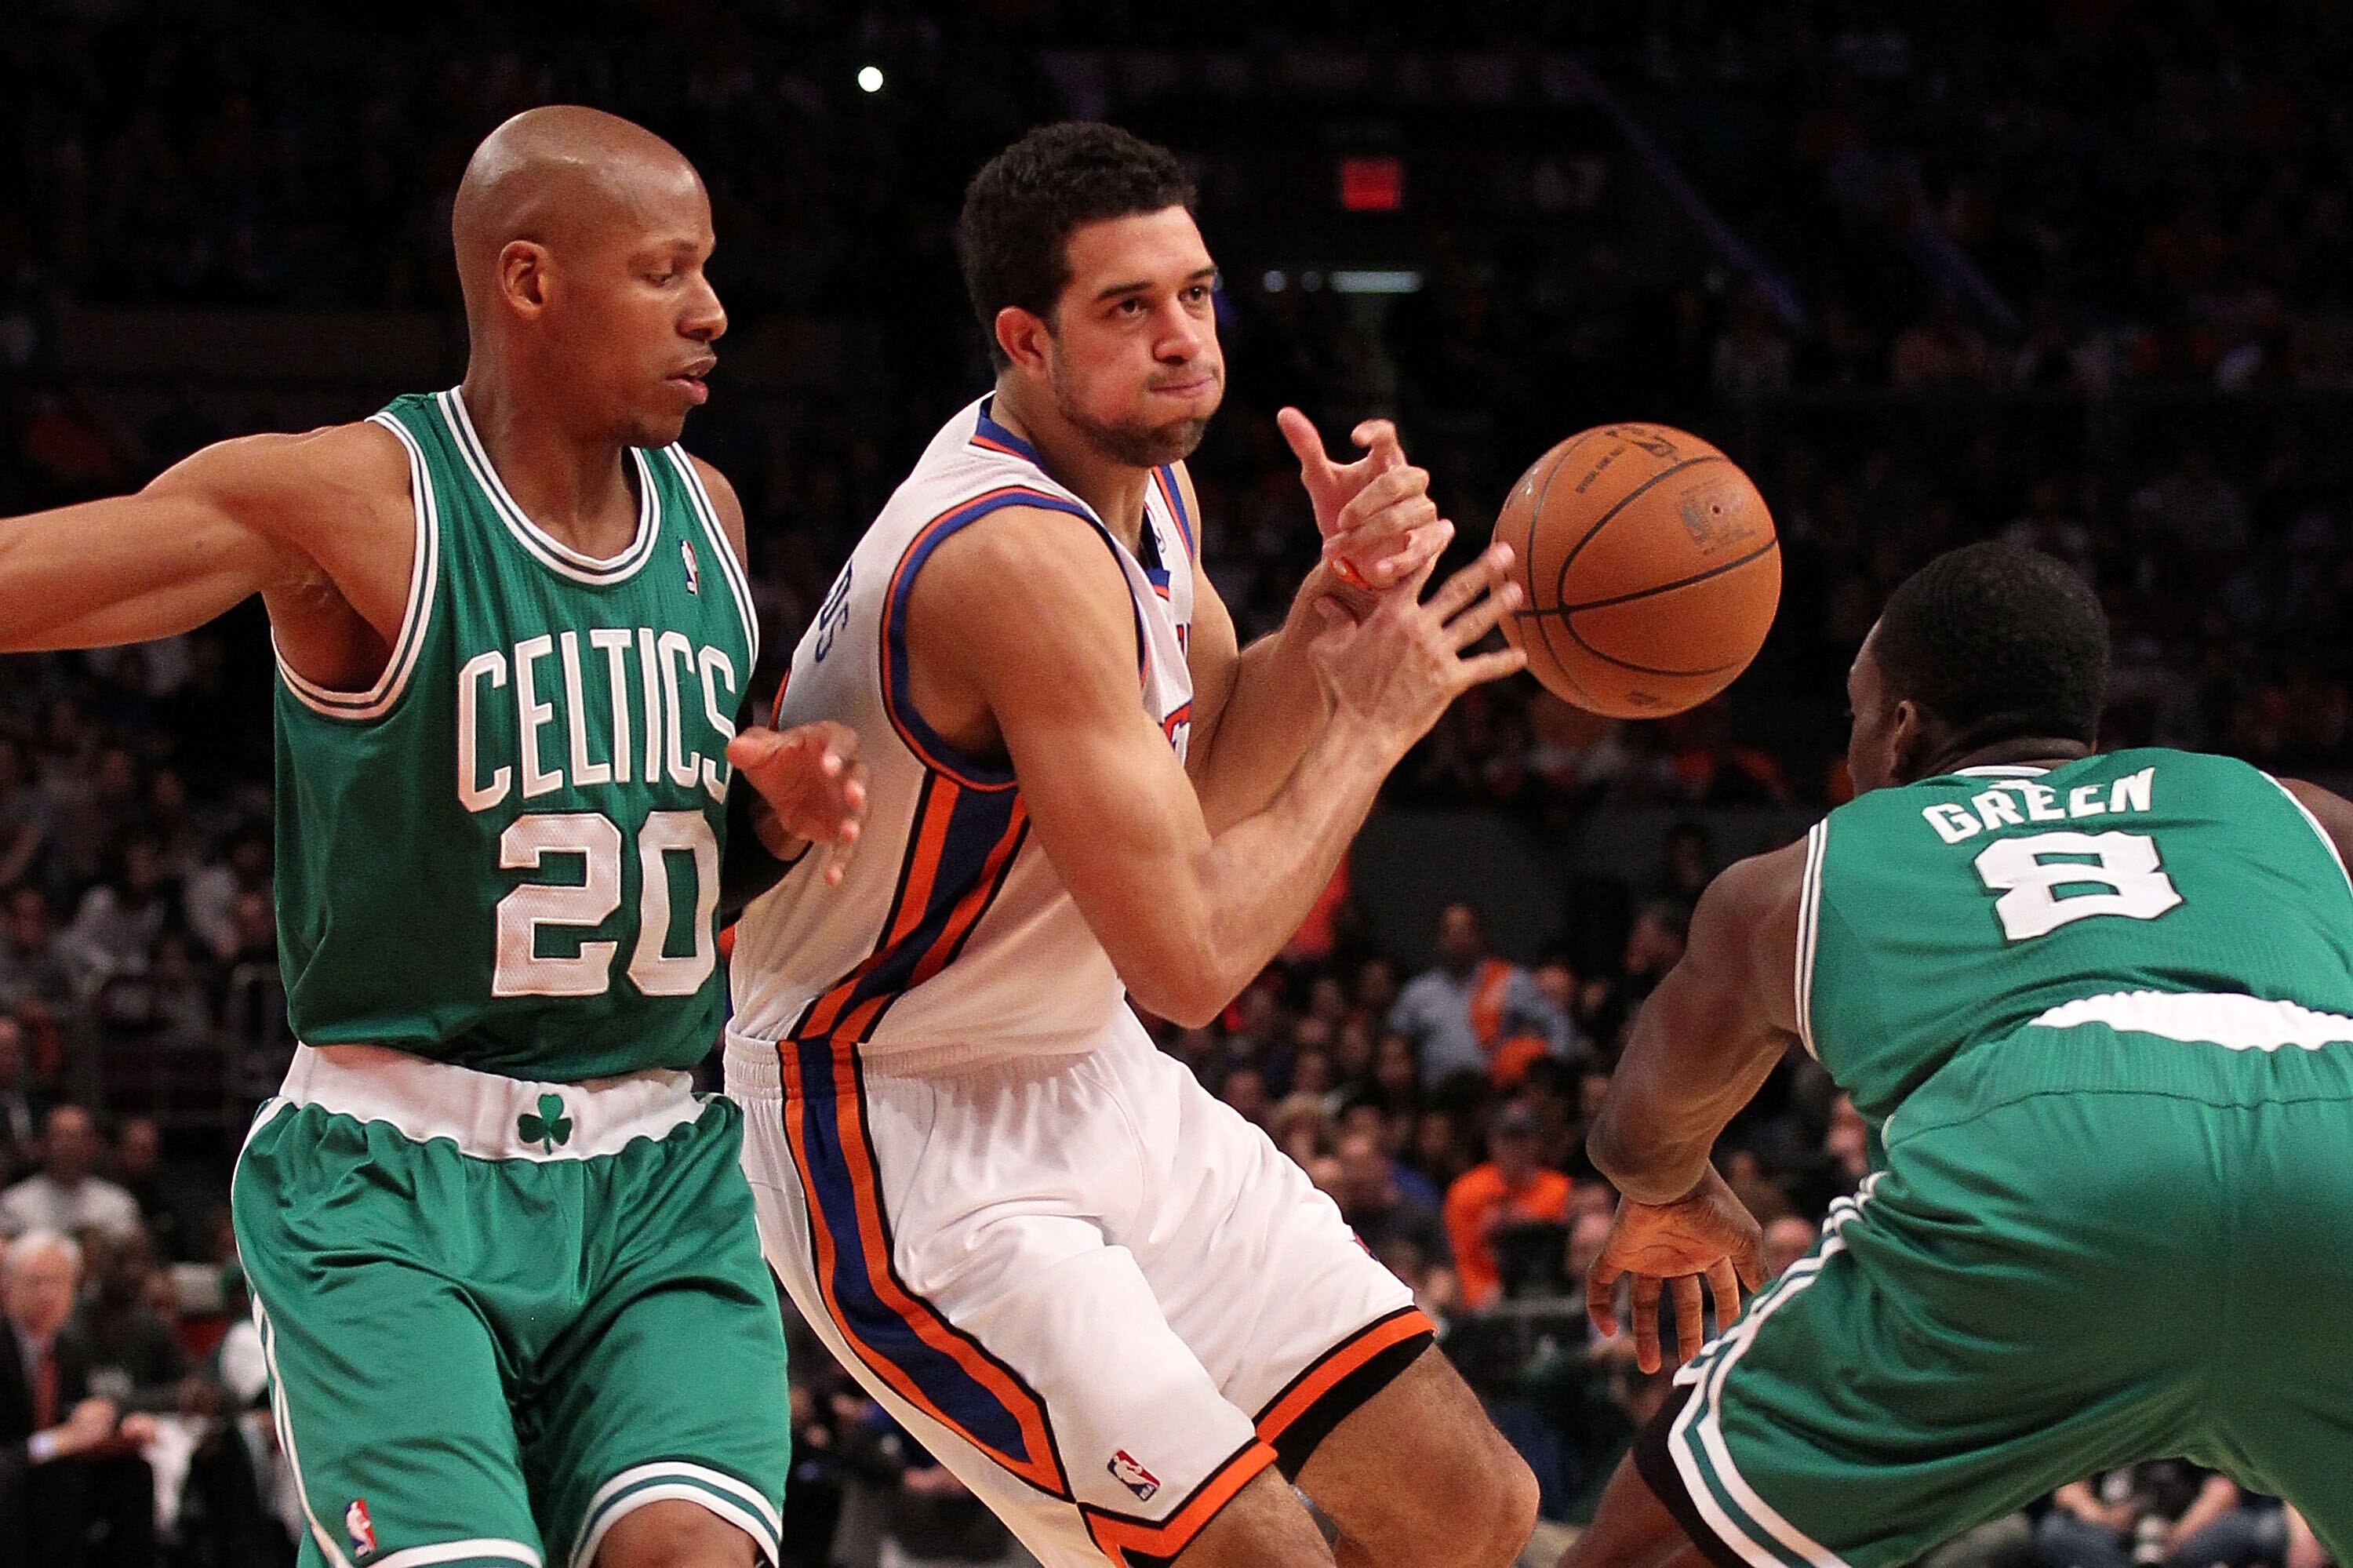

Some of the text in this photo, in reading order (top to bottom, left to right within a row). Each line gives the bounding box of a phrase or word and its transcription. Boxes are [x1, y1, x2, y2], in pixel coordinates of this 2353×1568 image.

[457, 627, 736, 813] CELTICS
[1921, 766, 2156, 845] GREEN
[491, 809, 720, 998] 20
[1973, 830, 2184, 941] 8
